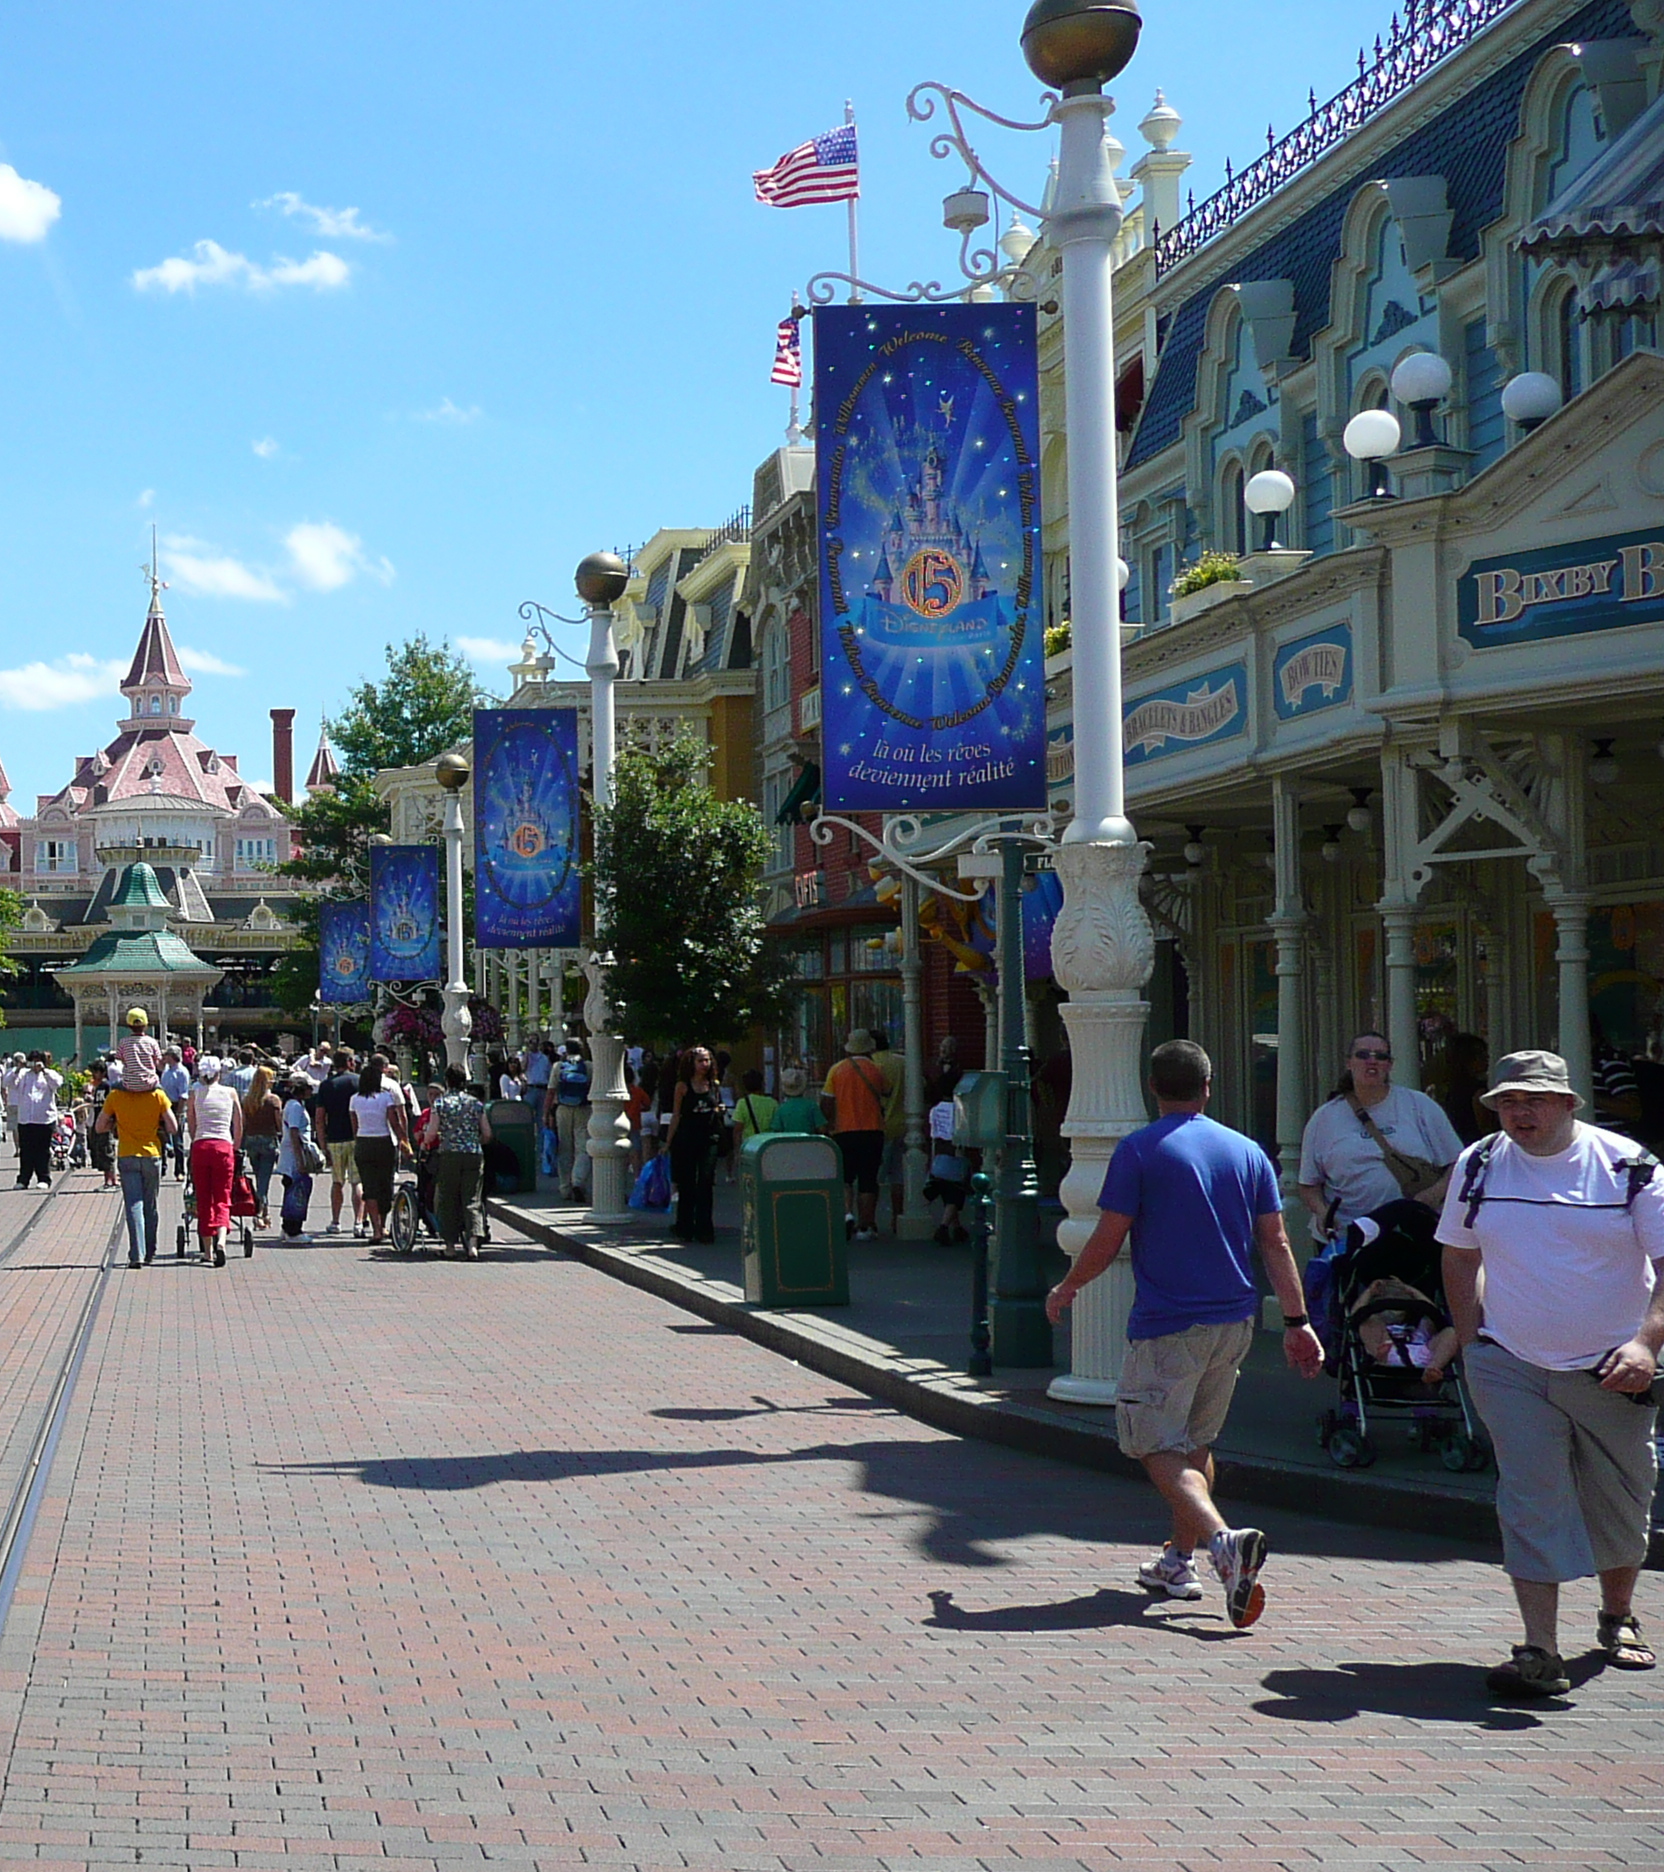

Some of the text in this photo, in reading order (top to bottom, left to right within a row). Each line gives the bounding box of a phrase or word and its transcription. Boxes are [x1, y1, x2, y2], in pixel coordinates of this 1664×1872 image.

[878, 330, 948, 357] Welcome
[907, 551, 960, 616] 15
[1473, 560, 1618, 626] BIXBY
[1287, 650, 1338, 691] BOW TIES
[1125, 705, 1177, 744] BRACELETS
[1189, 690, 1232, 734] BANGLES
[872, 738, 992, 763] là où les rêves
[848, 756, 1016, 789] deviennent réalité
